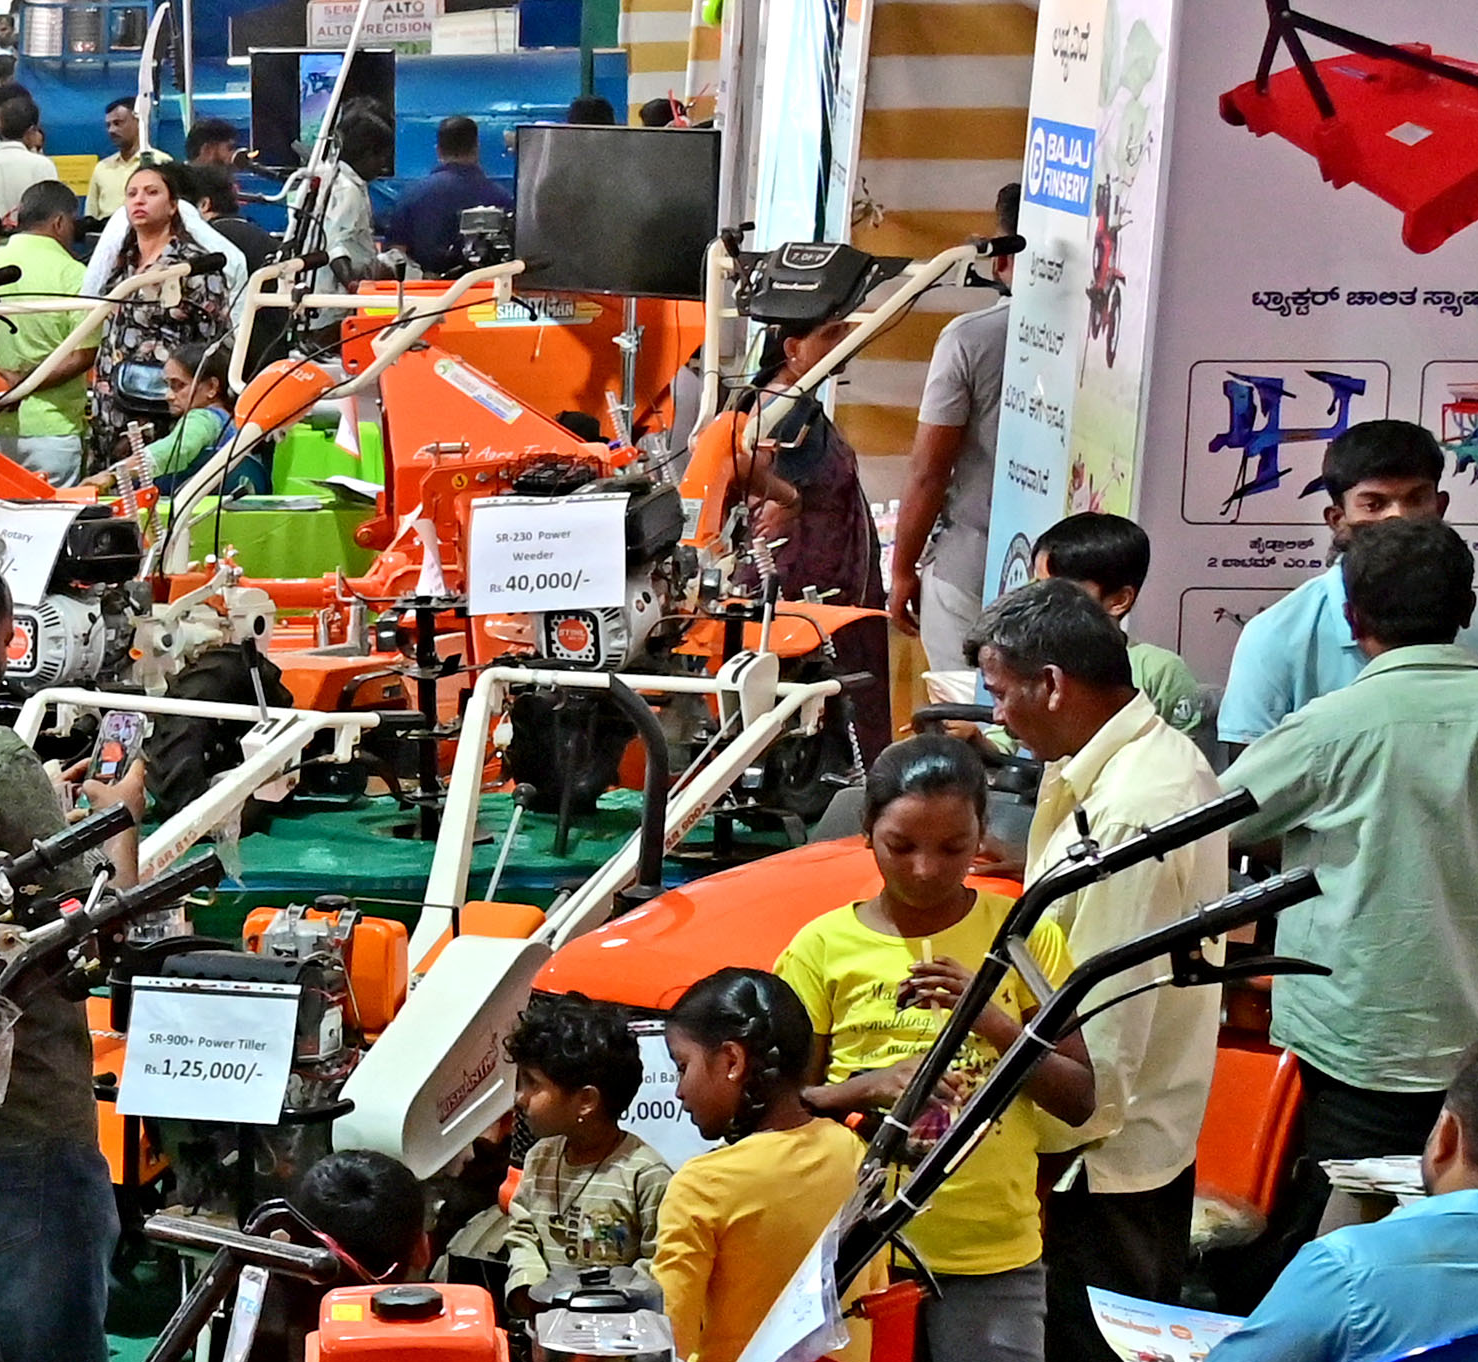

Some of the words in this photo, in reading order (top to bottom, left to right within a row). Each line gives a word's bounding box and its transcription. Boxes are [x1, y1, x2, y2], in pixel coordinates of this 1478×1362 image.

[1047, 133, 1093, 169] BAJAJ
[1042, 167, 1089, 204] FINSERV
[1, 529, 34, 543] Rotary
[495, 531, 533, 543] SR-230
[538, 530, 572, 541] Power
[512, 551, 555, 562] Weeder
[1207, 556, 1218, 569] 2
[148, 1032, 194, 1047] SR-900+
[198, 1036, 235, 1049] Power
[238, 1038, 267, 1051] Tiller
